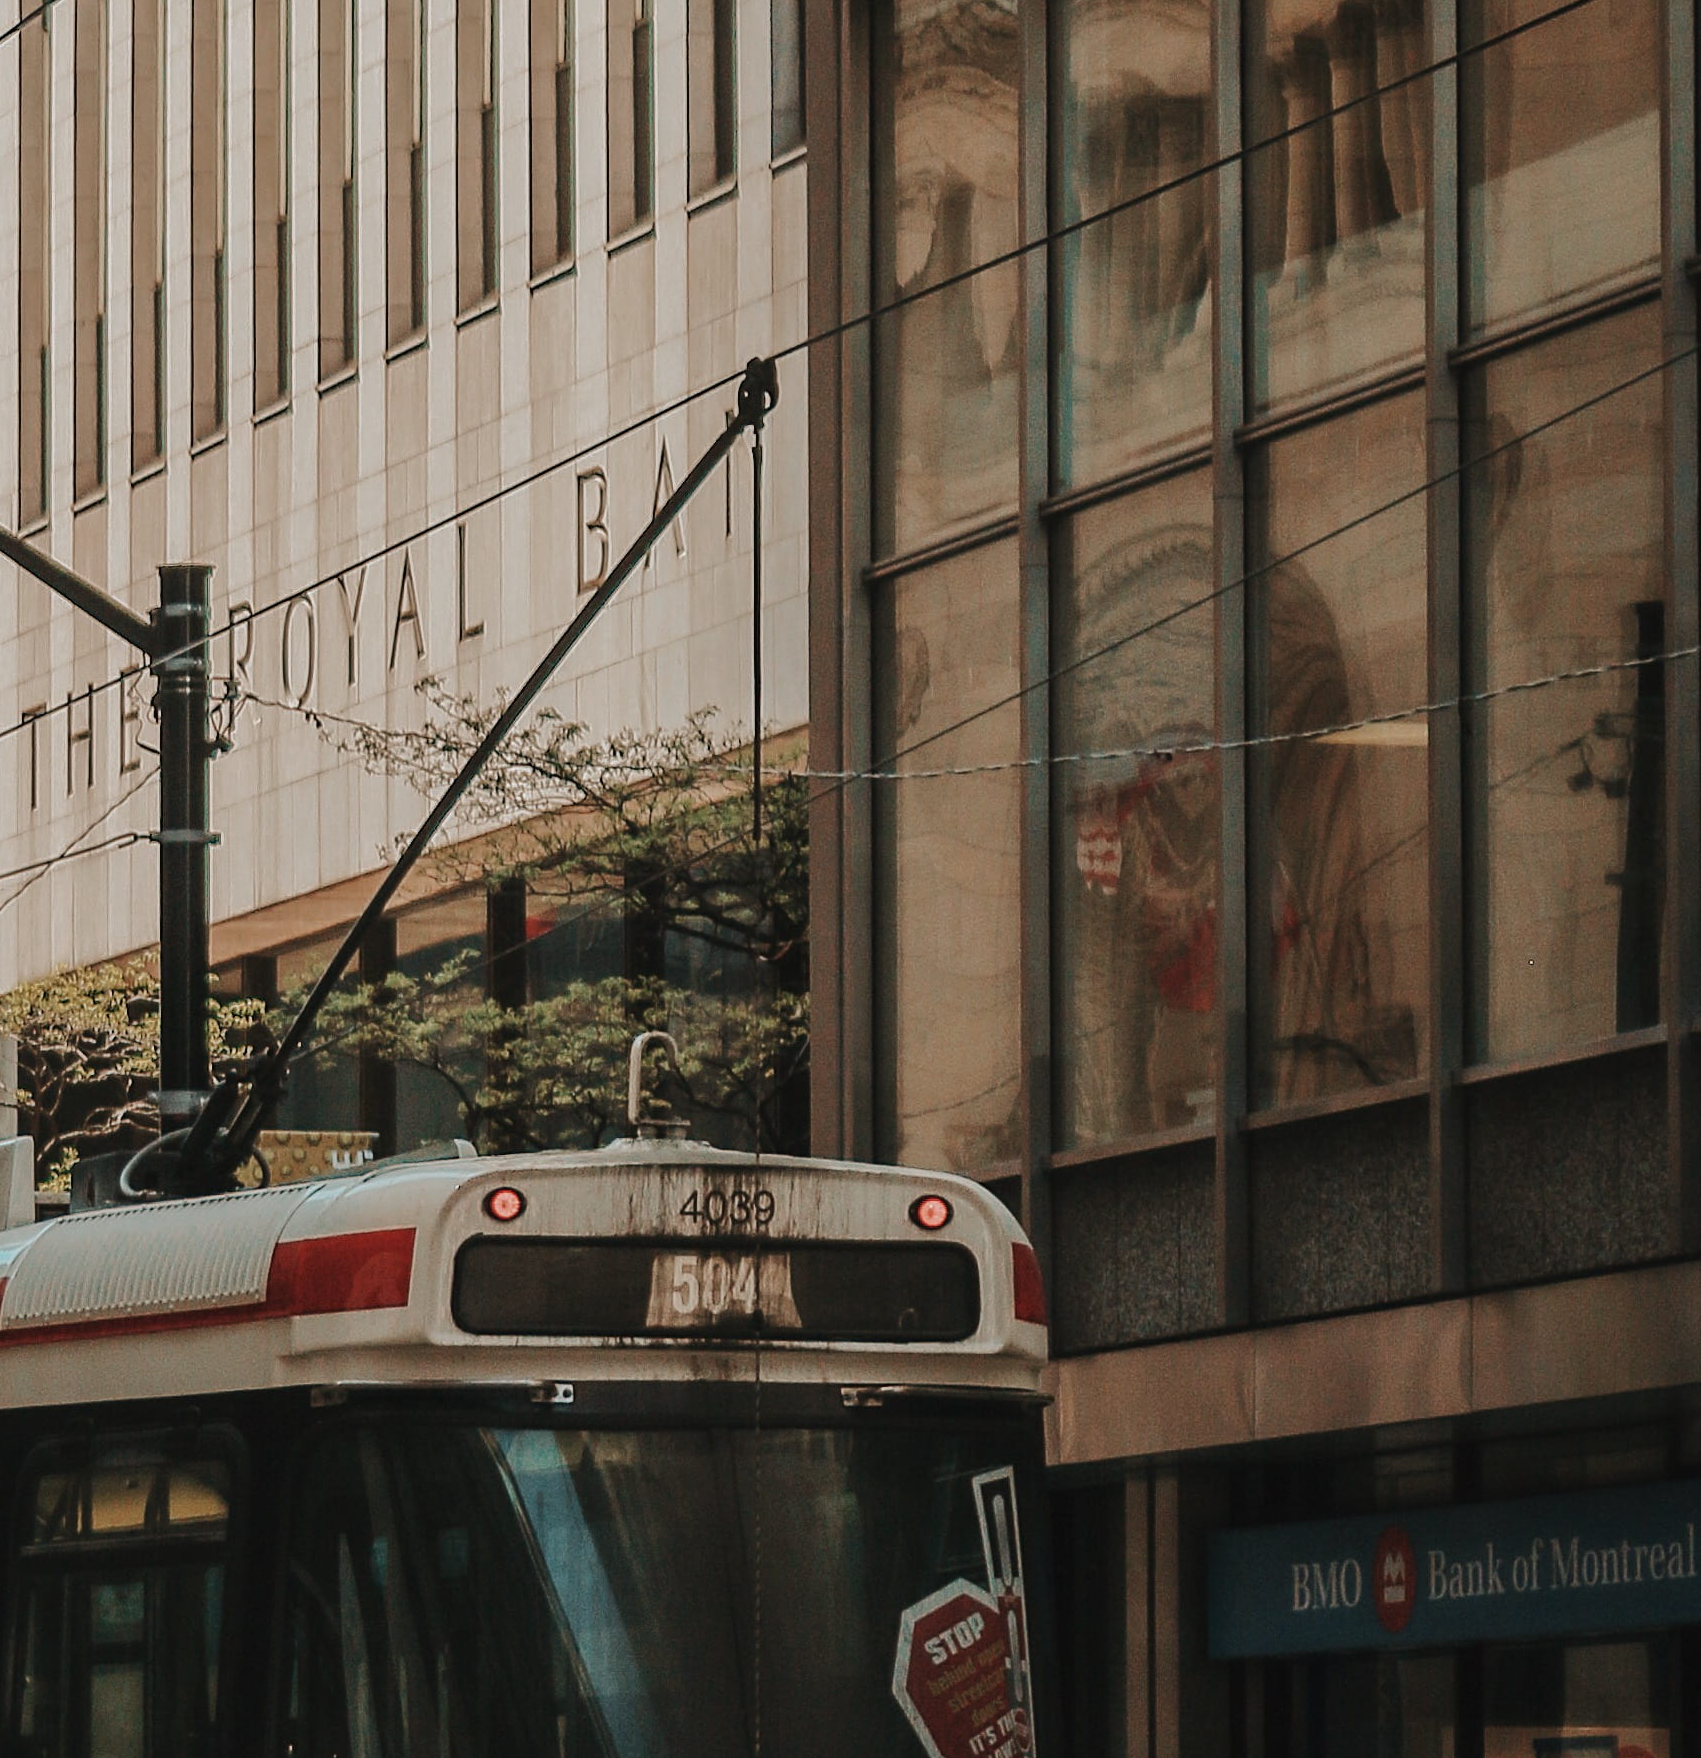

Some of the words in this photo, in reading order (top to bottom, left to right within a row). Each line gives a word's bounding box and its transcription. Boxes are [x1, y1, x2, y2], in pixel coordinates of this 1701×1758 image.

[21, 663, 142, 810] THE
[228, 519, 485, 733] ROYAL
[679, 1189, 776, 1225] 4039
[671, 1254, 759, 1315] 504
[1291, 1557, 1363, 1611] BMO
[1427, 1542, 1506, 1602] Bank
[1511, 1537, 1545, 1593] of
[1549, 1521, 1698, 1588] Montreal
[924, 1612, 985, 1666] STOP
[926, 1657, 978, 1696] behind
[969, 1725, 998, 1756] IT'S
